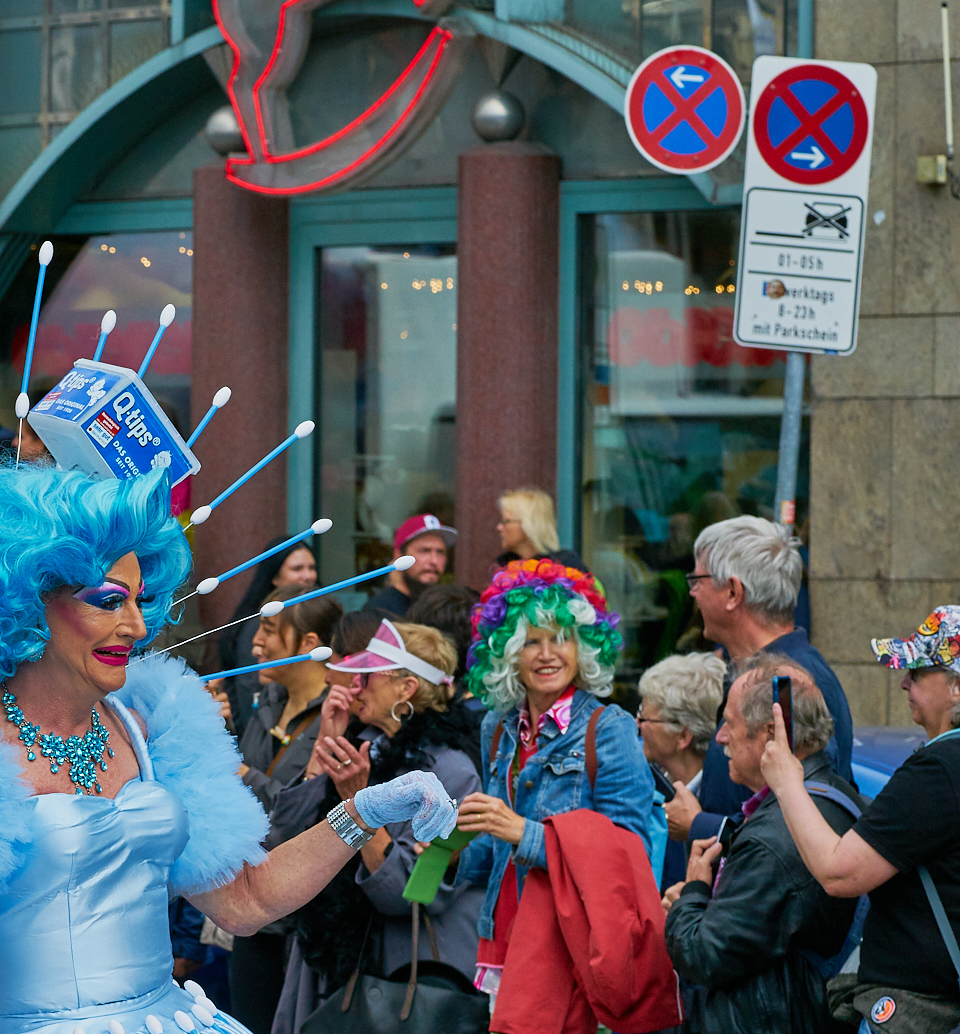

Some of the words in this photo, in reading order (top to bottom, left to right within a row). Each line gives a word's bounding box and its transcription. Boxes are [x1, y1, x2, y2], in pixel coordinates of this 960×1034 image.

[784, 286, 834, 305] werktags
[752, 321, 771, 335] mit
[774, 322, 838, 342] Parkschein
[101, 432, 110, 441] gut
[112, 440, 127, 457] DAS
[115, 457, 126, 469] SEIT
